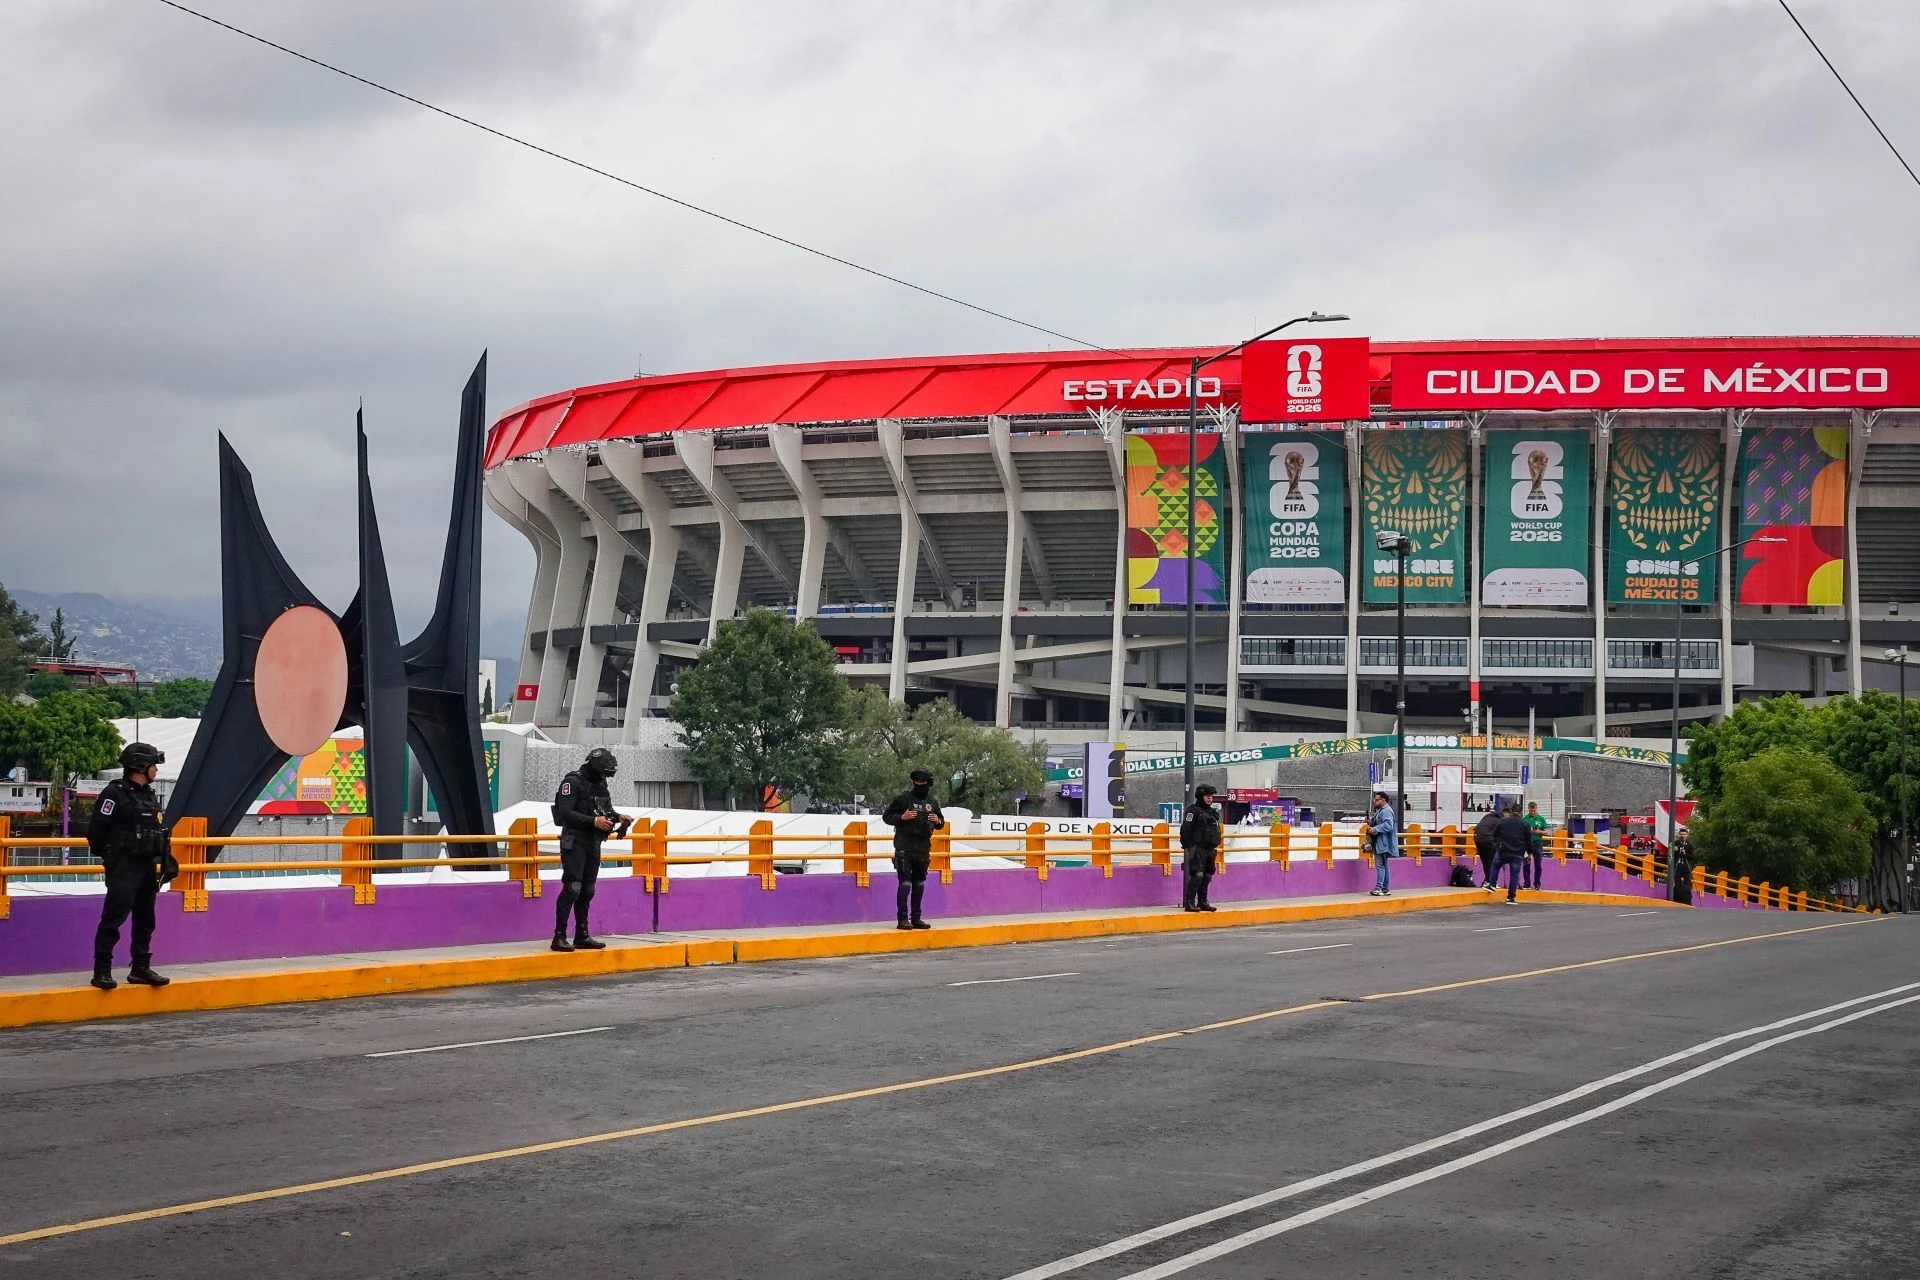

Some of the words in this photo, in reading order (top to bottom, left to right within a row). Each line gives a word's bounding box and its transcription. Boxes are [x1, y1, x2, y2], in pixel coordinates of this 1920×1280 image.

[1063, 377, 1220, 400] ESTADIO
[1426, 369, 1600, 394] CIUDAD
[1624, 369, 1685, 393] DE
[1704, 361, 1888, 393] MÉXICO
[1287, 404, 1321, 413] 2026
[1284, 503, 1306, 512] FIFA
[1525, 503, 1549, 512] FIFA
[1269, 522, 1319, 536] COPA
[1511, 522, 1543, 530] WORLD
[1544, 522, 1562, 530] CUP
[1269, 537, 1319, 546] MUNDIAL
[1510, 531, 1562, 542] 2026
[1269, 547, 1320, 558] 2026
[1411, 559, 1454, 574] ARE
[1426, 576, 1454, 587] CITY
[1625, 577, 1679, 588] CIUDAD
[1681, 578, 1699, 589] DE
[525, 687, 533, 697] 6
[1404, 735, 1458, 747] SOMOS
[1494, 737, 1506, 748] DE
[1125, 760, 1154, 772] DIAL
[1156, 758, 1172, 769] DE
[1194, 753, 1218, 765] FIFA
[1220, 750, 1262, 762] 2026
[1227, 793, 1236, 801] 30
[1059, 823, 1081, 833] DE
